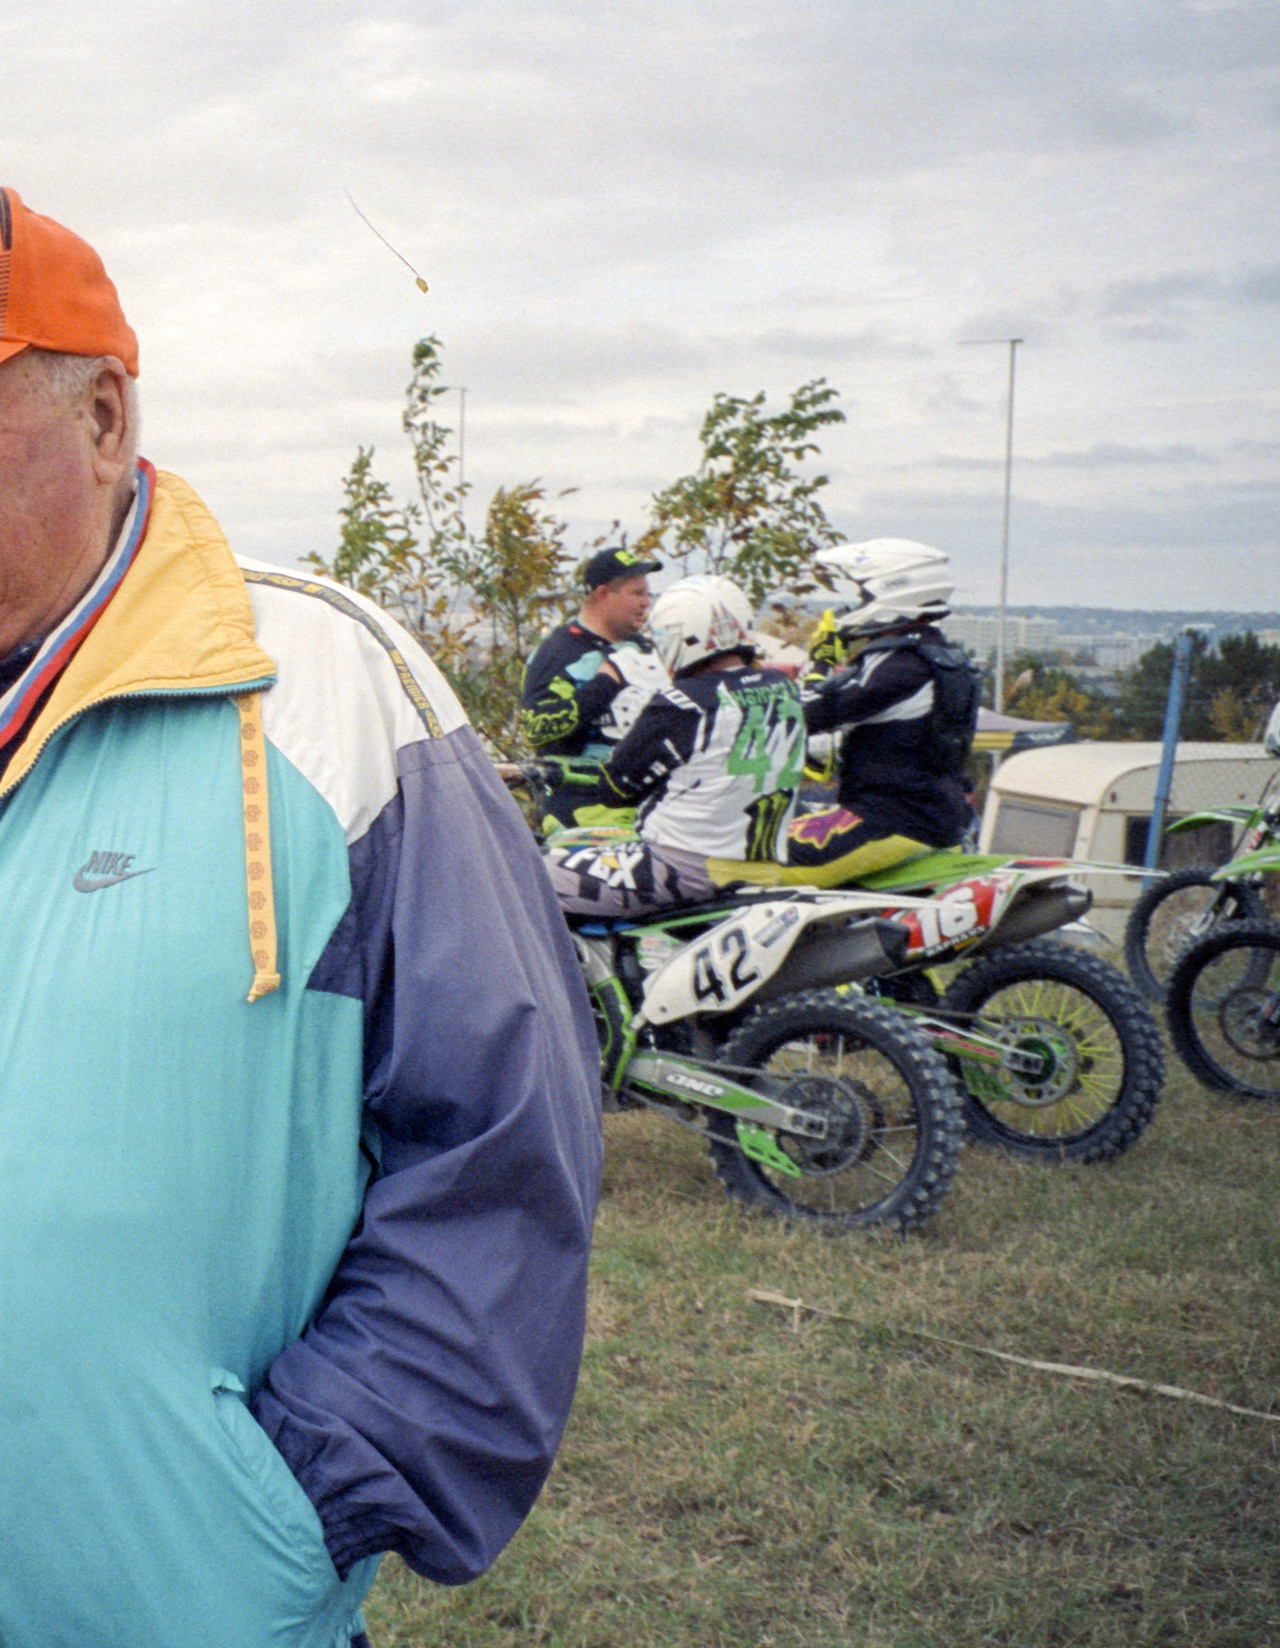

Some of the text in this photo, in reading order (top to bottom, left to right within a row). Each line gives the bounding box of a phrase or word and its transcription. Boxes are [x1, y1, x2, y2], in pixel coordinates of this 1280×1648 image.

[83, 851, 136, 876] NIKE
[915, 886, 979, 948] 16
[692, 926, 760, 1002] 42
